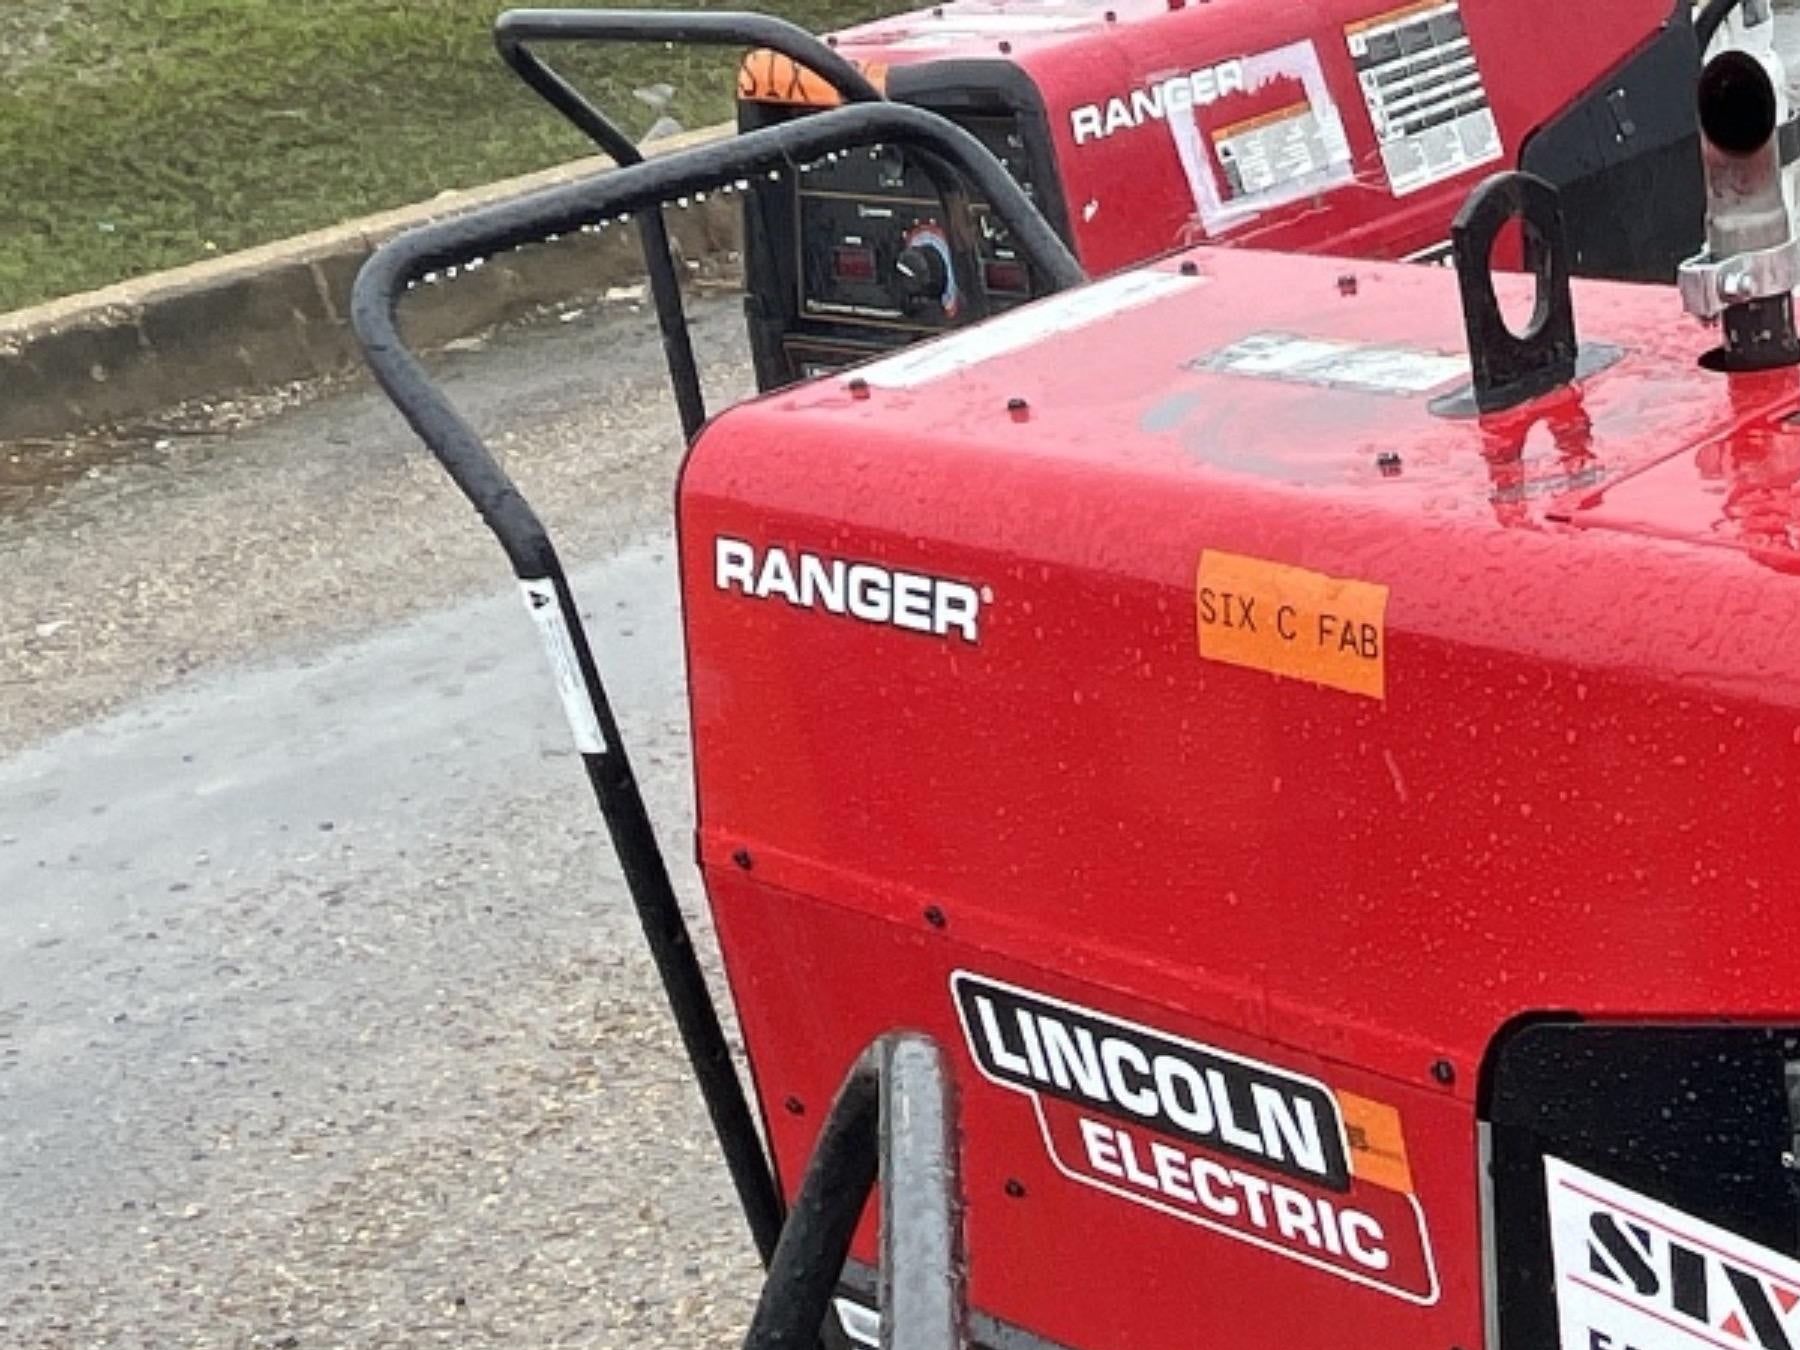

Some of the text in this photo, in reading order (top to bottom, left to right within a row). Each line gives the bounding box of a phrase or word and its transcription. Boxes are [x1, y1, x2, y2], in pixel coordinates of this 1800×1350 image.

[1070, 59, 1245, 145] RANGER
[1200, 587, 1378, 659] SIX C FAB
[974, 995, 1329, 1175] LINCOLN
[1079, 1117, 1390, 1271] ELECTRIC
